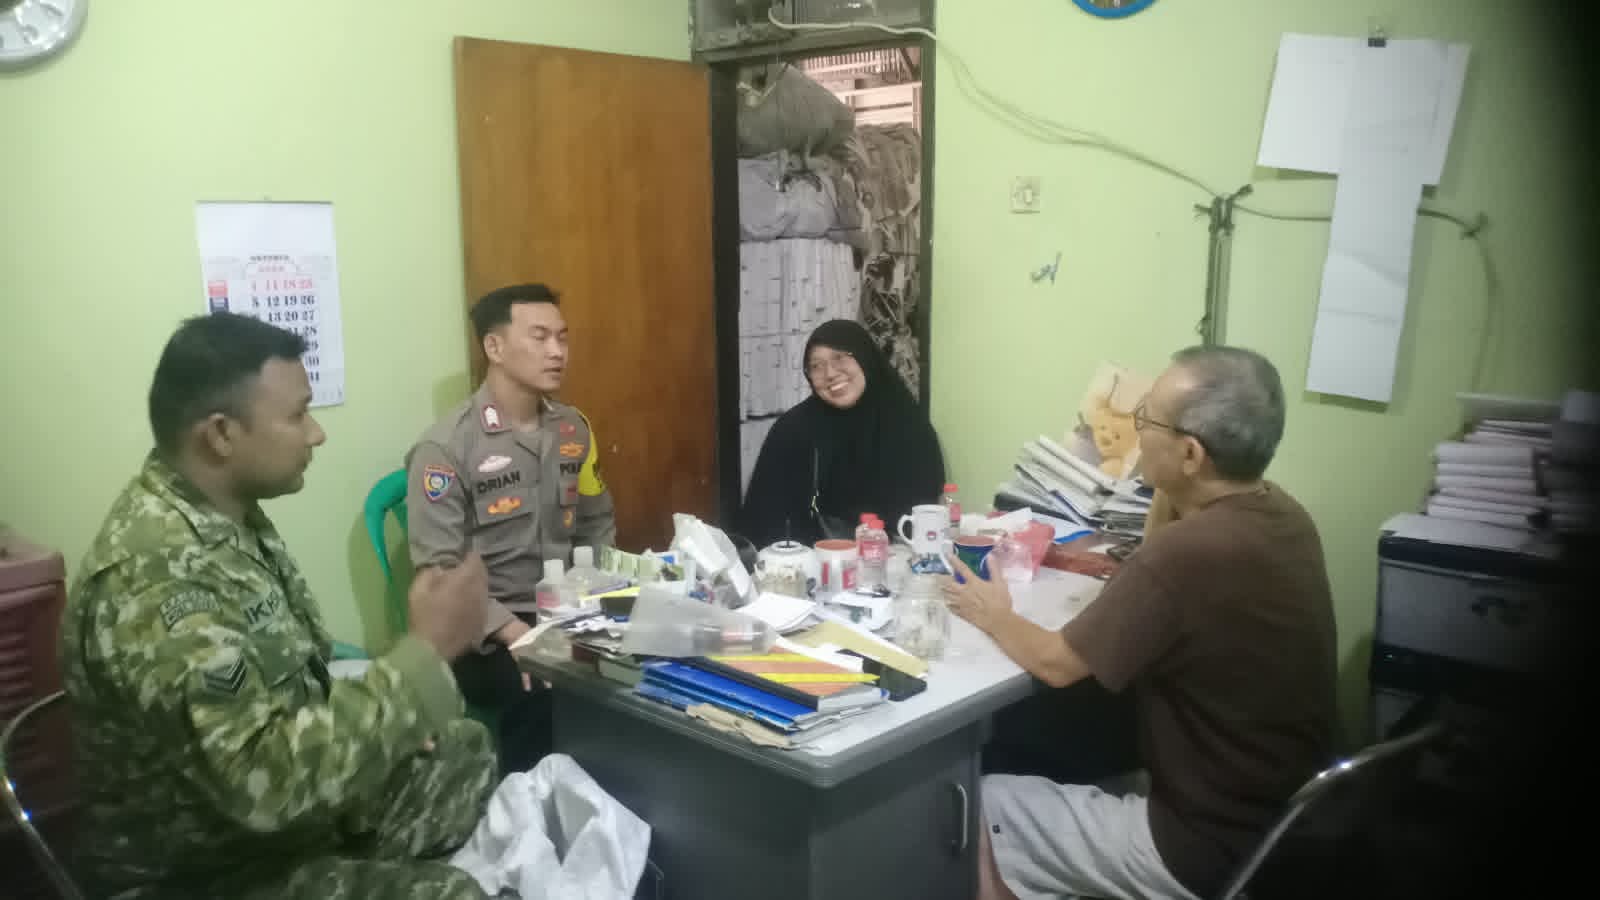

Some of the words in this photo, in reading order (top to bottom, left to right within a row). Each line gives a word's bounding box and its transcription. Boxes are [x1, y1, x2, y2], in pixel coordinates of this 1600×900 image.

[267, 295, 280, 307] 12
[284, 295, 297, 306] 19
[300, 295, 315, 306] 26
[268, 311, 281, 323] 13
[285, 311, 298, 322] 20
[302, 310, 315, 322] 27
[303, 326, 317, 338] 28
